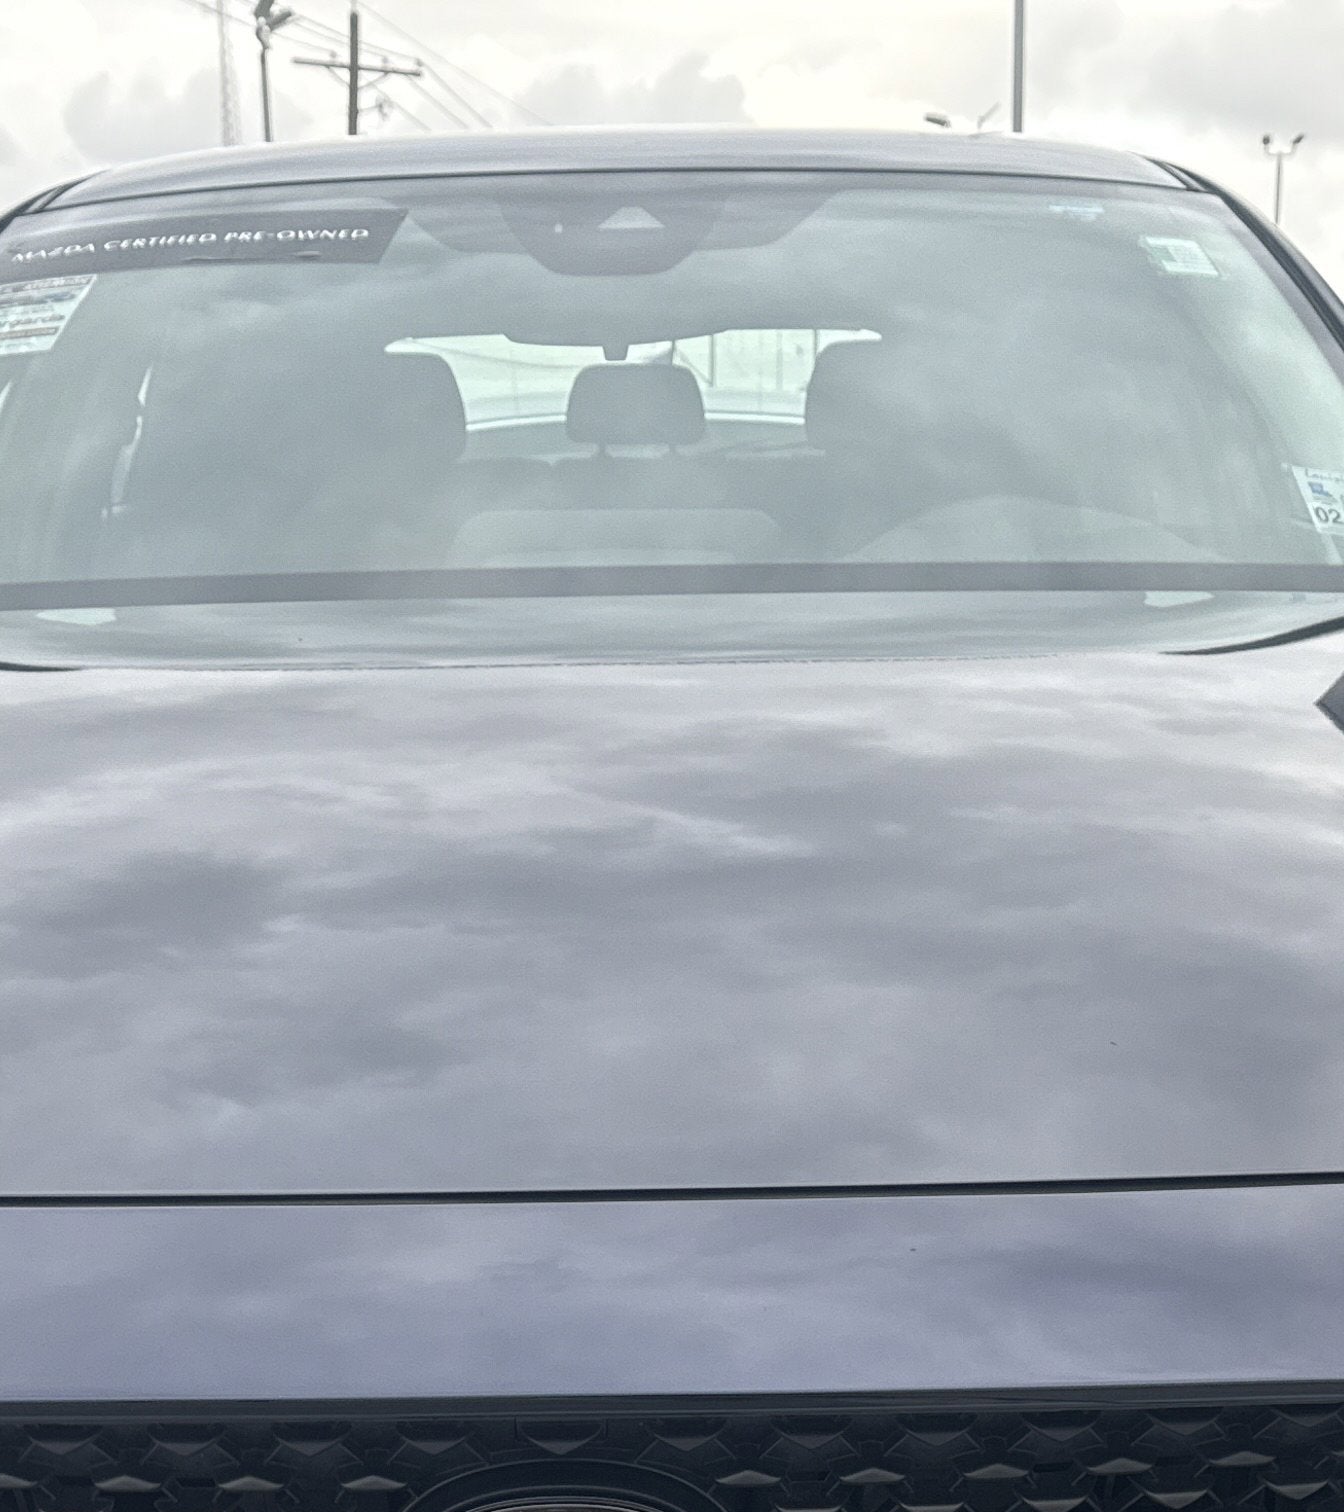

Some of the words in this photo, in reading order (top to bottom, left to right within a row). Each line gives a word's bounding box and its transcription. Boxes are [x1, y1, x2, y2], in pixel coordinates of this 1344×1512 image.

[11, 243, 95, 263] MAZDA
[104, 231, 217, 249] CERTIFIED
[224, 228, 369, 243] PRE-OWNED
[1315, 506, 1344, 525] 02
